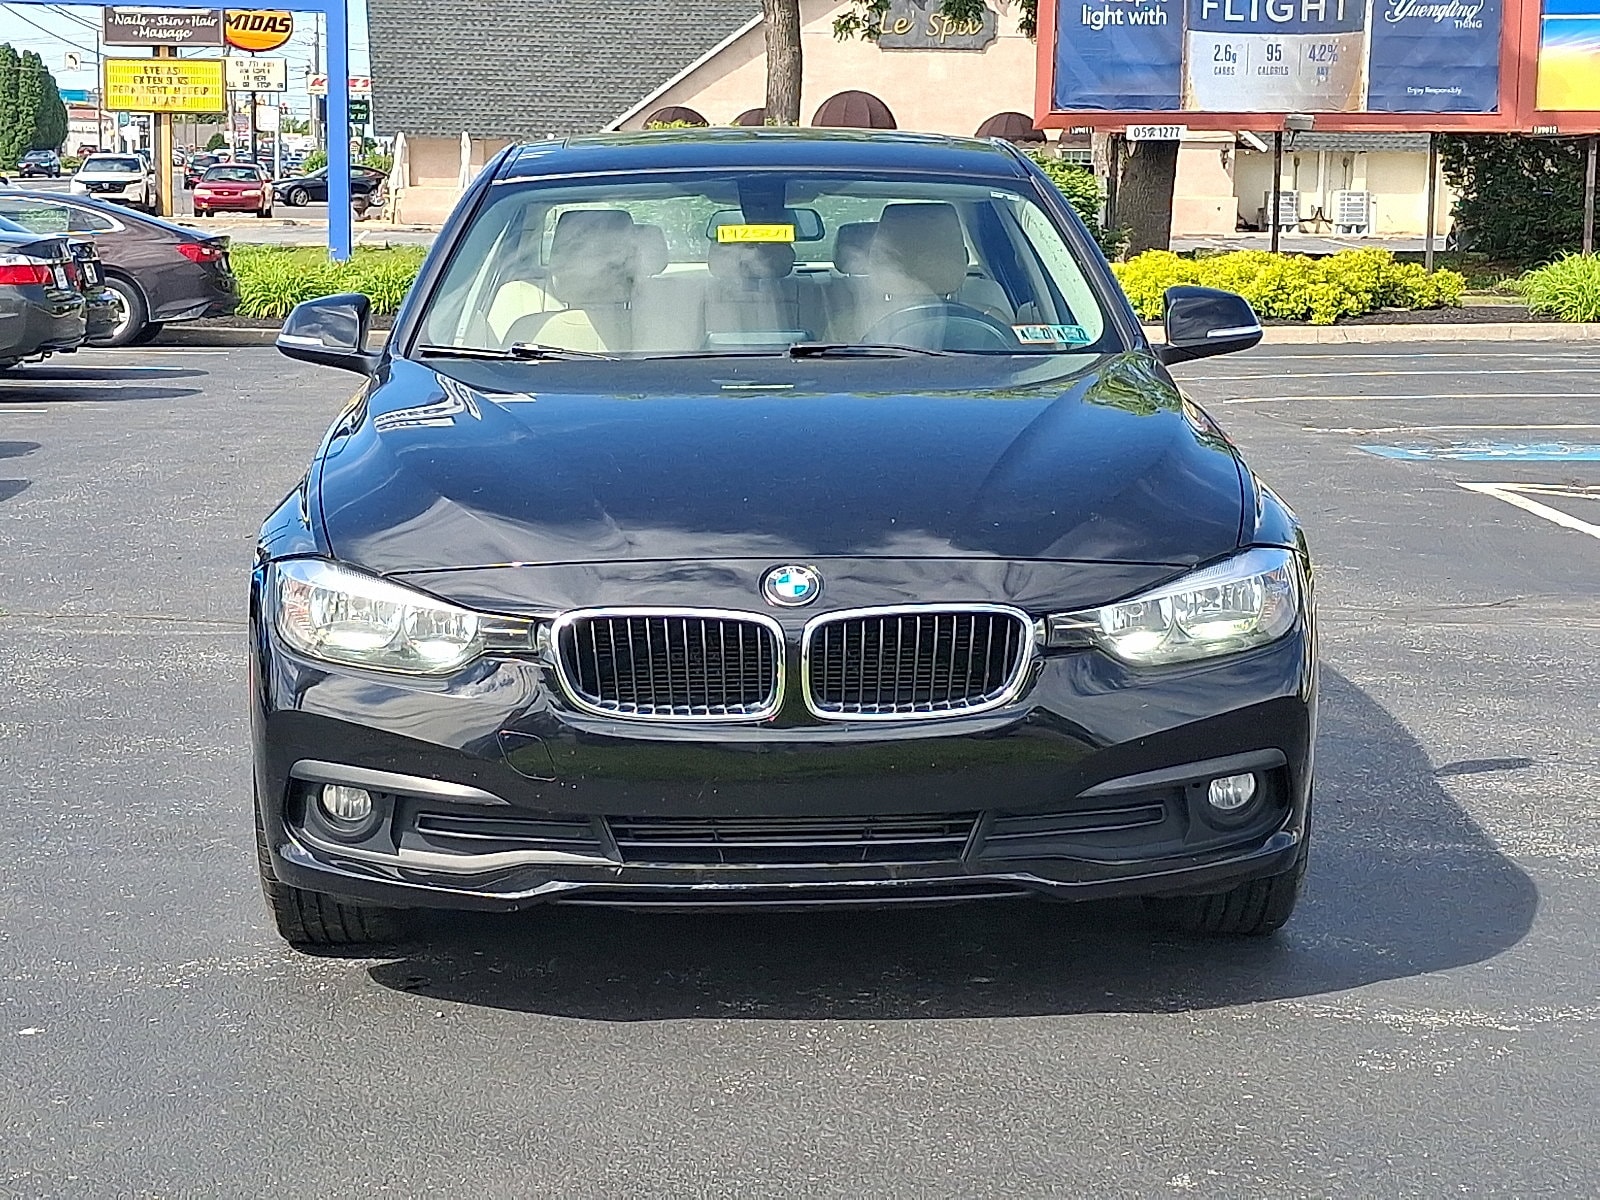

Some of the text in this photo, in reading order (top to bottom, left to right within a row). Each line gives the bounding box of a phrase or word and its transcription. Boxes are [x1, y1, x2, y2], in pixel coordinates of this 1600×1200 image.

[114, 13, 218, 27] Nails Skin Hair
[226, 13, 291, 33] MIDAS
[1081, 4, 1167, 30] light with
[138, 26, 193, 41] Massage
[926, 13, 983, 44] Spa
[1213, 44, 1237, 63] 2.6g
[1266, 44, 1282, 62] 95
[1308, 44, 1338, 63] 4.2%
